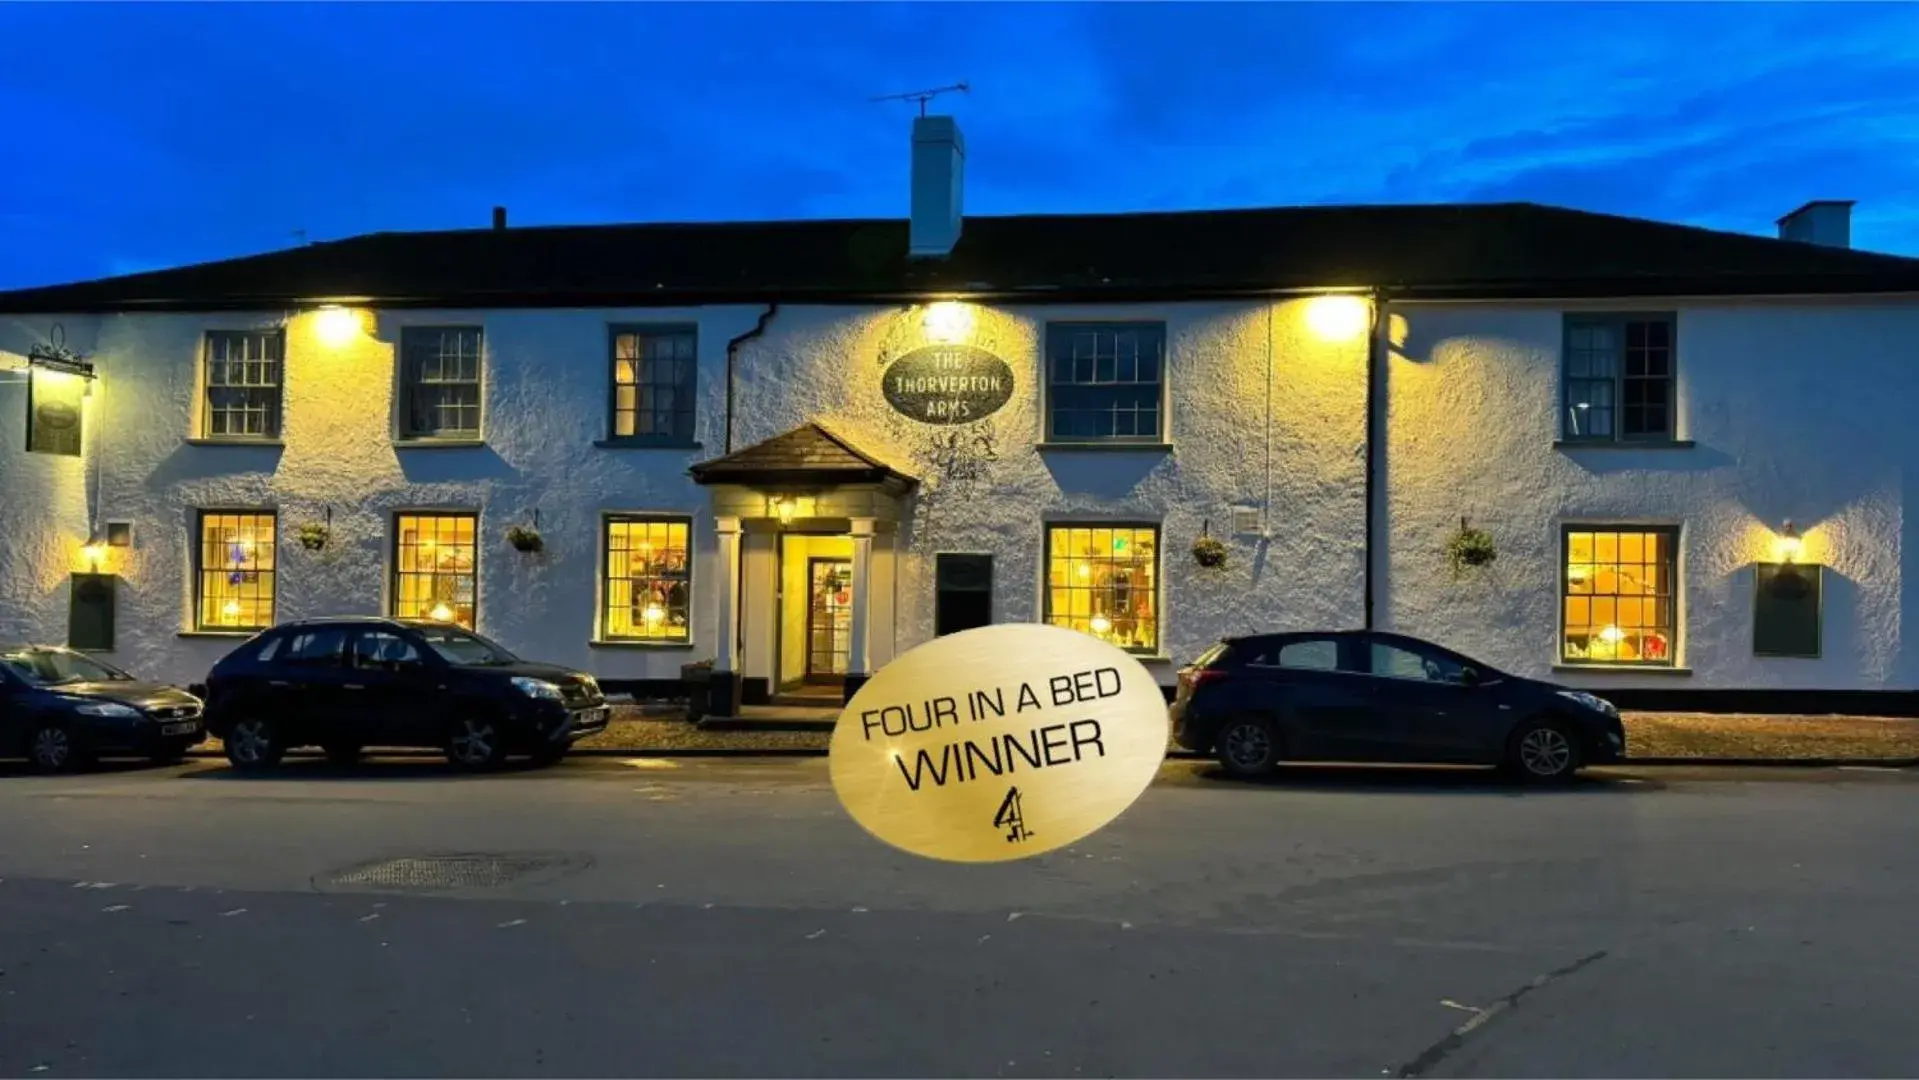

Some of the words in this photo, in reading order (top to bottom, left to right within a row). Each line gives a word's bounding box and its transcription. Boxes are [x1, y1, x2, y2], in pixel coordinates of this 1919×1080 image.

[932, 352, 962, 369] THE
[895, 376, 1001, 393] THORVERTON
[926, 400, 971, 417] ARMS
